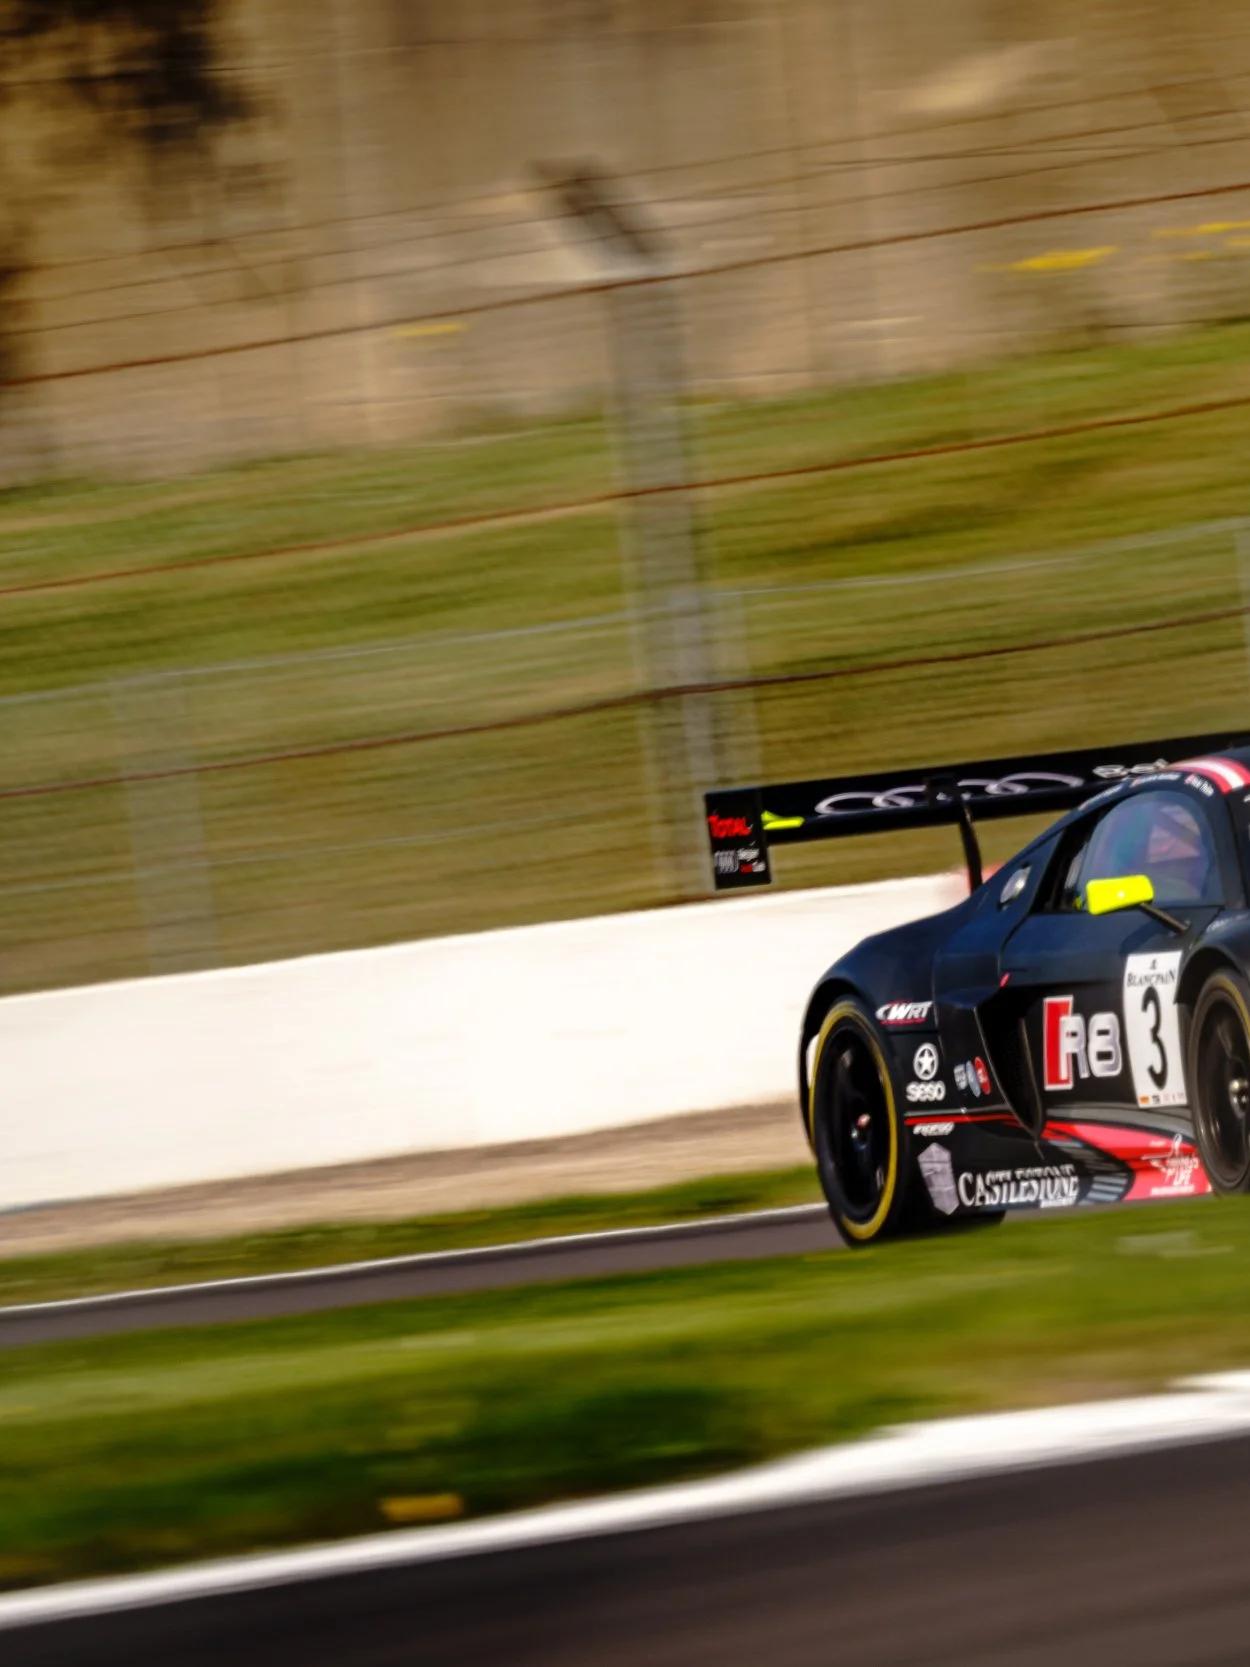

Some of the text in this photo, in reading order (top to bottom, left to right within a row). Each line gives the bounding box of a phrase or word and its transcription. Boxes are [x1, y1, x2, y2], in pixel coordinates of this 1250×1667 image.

[707, 813, 753, 838] TOTAL
[1126, 968, 1177, 988] BLANCPAIN
[886, 1000, 933, 1021] WRT
[1058, 1010, 1123, 1081] R8
[1141, 985, 1168, 1090] 3
